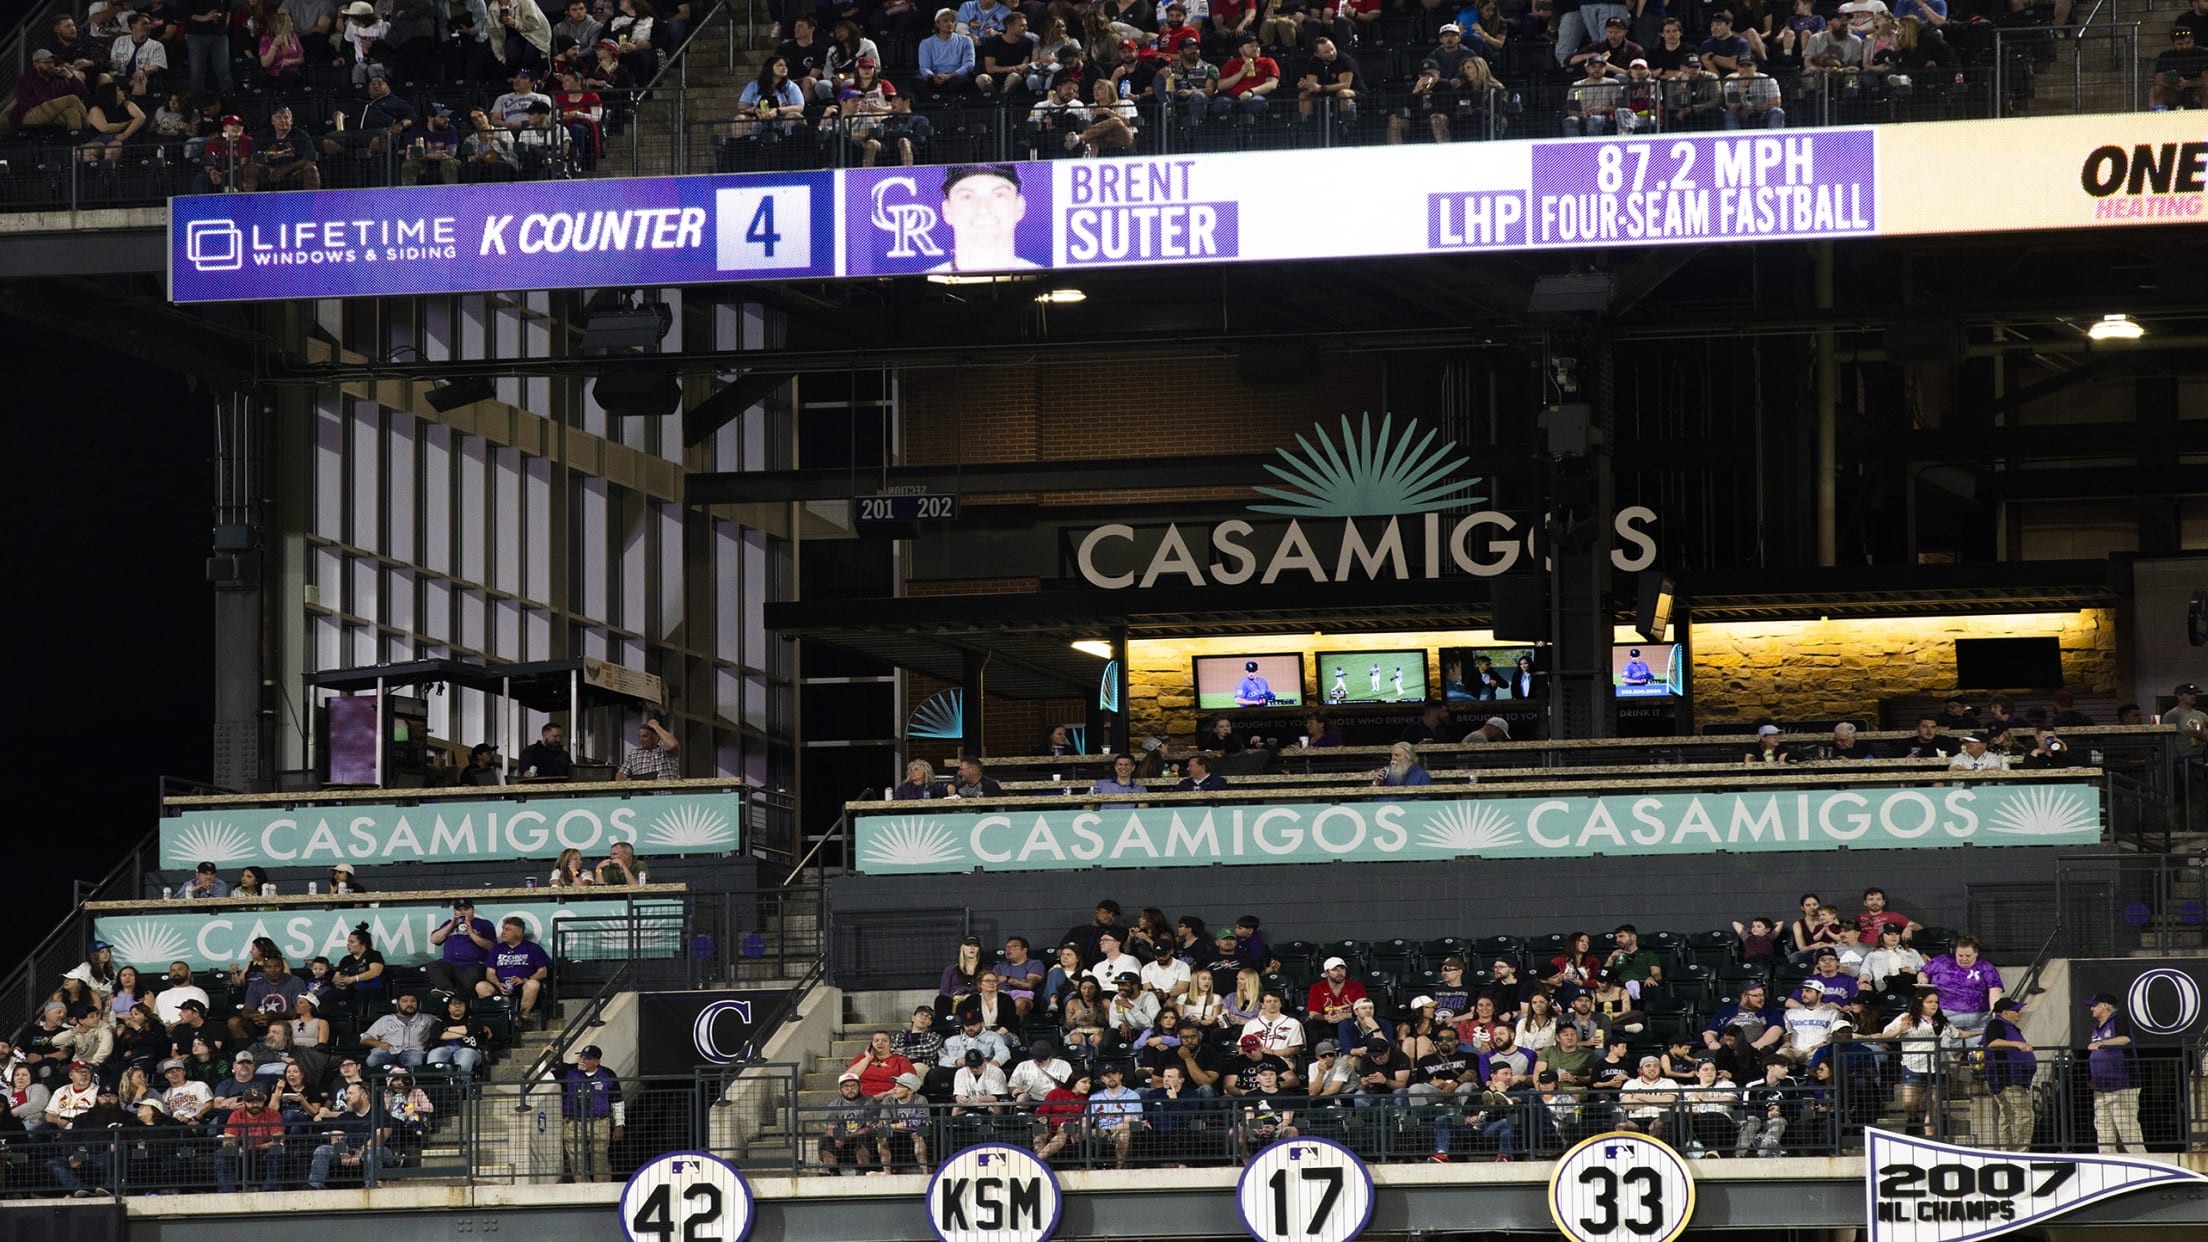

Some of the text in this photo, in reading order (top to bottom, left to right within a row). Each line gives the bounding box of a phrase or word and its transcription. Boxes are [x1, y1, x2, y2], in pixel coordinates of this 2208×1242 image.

[1071, 160, 1196, 204] BRENT
[1599, 137, 1814, 193] 87.2 MPH
[2081, 141, 2208, 197] ONE
[252, 217, 456, 250] LIFETIME
[479, 206, 707, 256] K COUNTER
[745, 194, 782, 258] 4
[1070, 204, 1217, 260] SUTER
[1440, 195, 1522, 246] LHP
[1541, 183, 1869, 242] FOUR-SEAM FASTBALL
[2095, 195, 2203, 219] HEATING
[253, 246, 457, 266] WINDOWS & SIDING
[861, 496, 952, 520] 201 202
[1231, 719, 1273, 729] ROUGHT
[260, 808, 638, 860] CASAMIGOS
[970, 805, 1408, 864] CASAMIGOS
[1526, 789, 1979, 848] CASAMIGOS
[196, 909, 578, 962] CASAMIOS
[2128, 968, 2200, 1035] O
[693, 999, 752, 1064] C
[942, 1177, 1041, 1231] KSM
[1269, 1166, 1344, 1235] 17
[1579, 1166, 1665, 1235] 33
[1879, 1162, 2077, 1198] 2007
[633, 1183, 722, 1242] 42
[1879, 1200, 2016, 1222] NL CHAMPS
